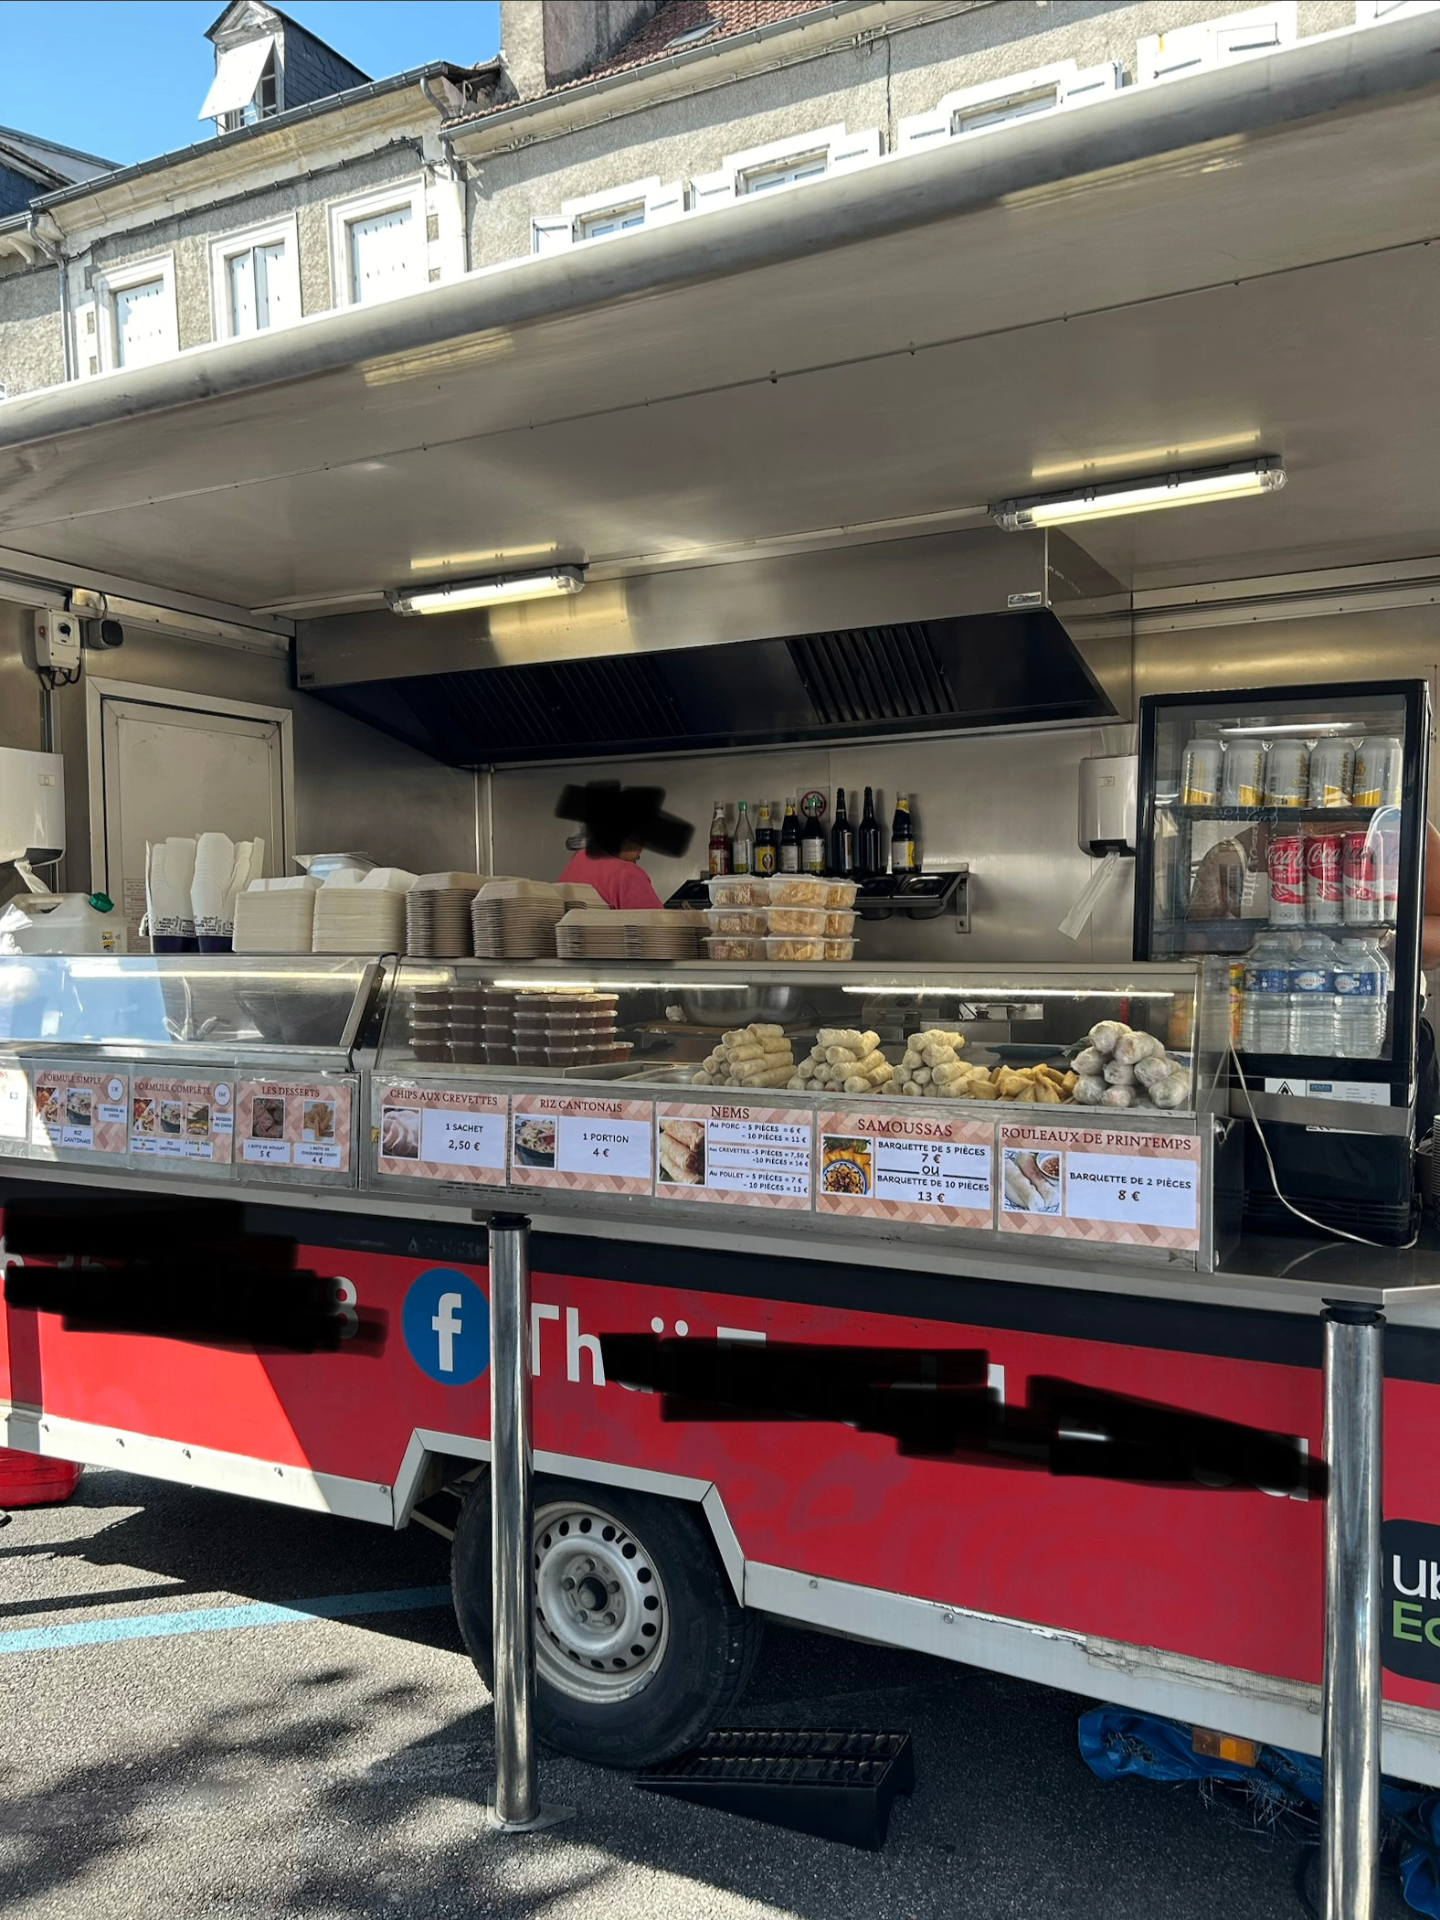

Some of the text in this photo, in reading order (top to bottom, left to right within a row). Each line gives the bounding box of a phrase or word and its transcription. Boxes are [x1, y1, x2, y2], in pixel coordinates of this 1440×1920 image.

[44, 1074, 102, 1084] FORMULE SIMPLE
[134, 1082, 211, 1095] FORMULE COMPLÈTE
[262, 1086, 320, 1097] LES DESSERTS
[390, 1089, 497, 1105] CHIPS AUX CREVETTES
[540, 1099, 622, 1112] RIZ CANTONAIS
[711, 1106, 749, 1119] NEMS
[446, 1123, 483, 1133] 1 SACHET
[754, 1123, 779, 1132] PIÈCES
[858, 1119, 952, 1137] SAMOUSSAS
[591, 1133, 629, 1143] PORTION
[758, 1132, 782, 1142] PIÈCES
[1001, 1127, 1191, 1150] ROULEAUX DE PRINTEMPS
[448, 1140, 480, 1151] 2,50 €
[878, 1141, 929, 1151] BARQUETTE
[954, 1144, 985, 1156] PIÈCES
[593, 1148, 609, 1157] 4 €
[761, 1148, 783, 1157] PIÈCES
[921, 1153, 941, 1163] 7 €
[765, 1157, 787, 1166] PIÈCES
[922, 1166, 939, 1175] OU
[720, 1171, 743, 1179] POULET
[759, 1173, 782, 1182] PIÈCES
[1070, 1172, 1192, 1189] BARQUETTE DE 2 PIÈCES
[760, 1182, 784, 1191] PIÈCES
[877, 1175, 928, 1186] BARQUETTE
[958, 1181, 989, 1191] PIÈCES
[918, 1191, 945, 1203] 13 €
[1118, 1190, 1141, 1201] 8 €
